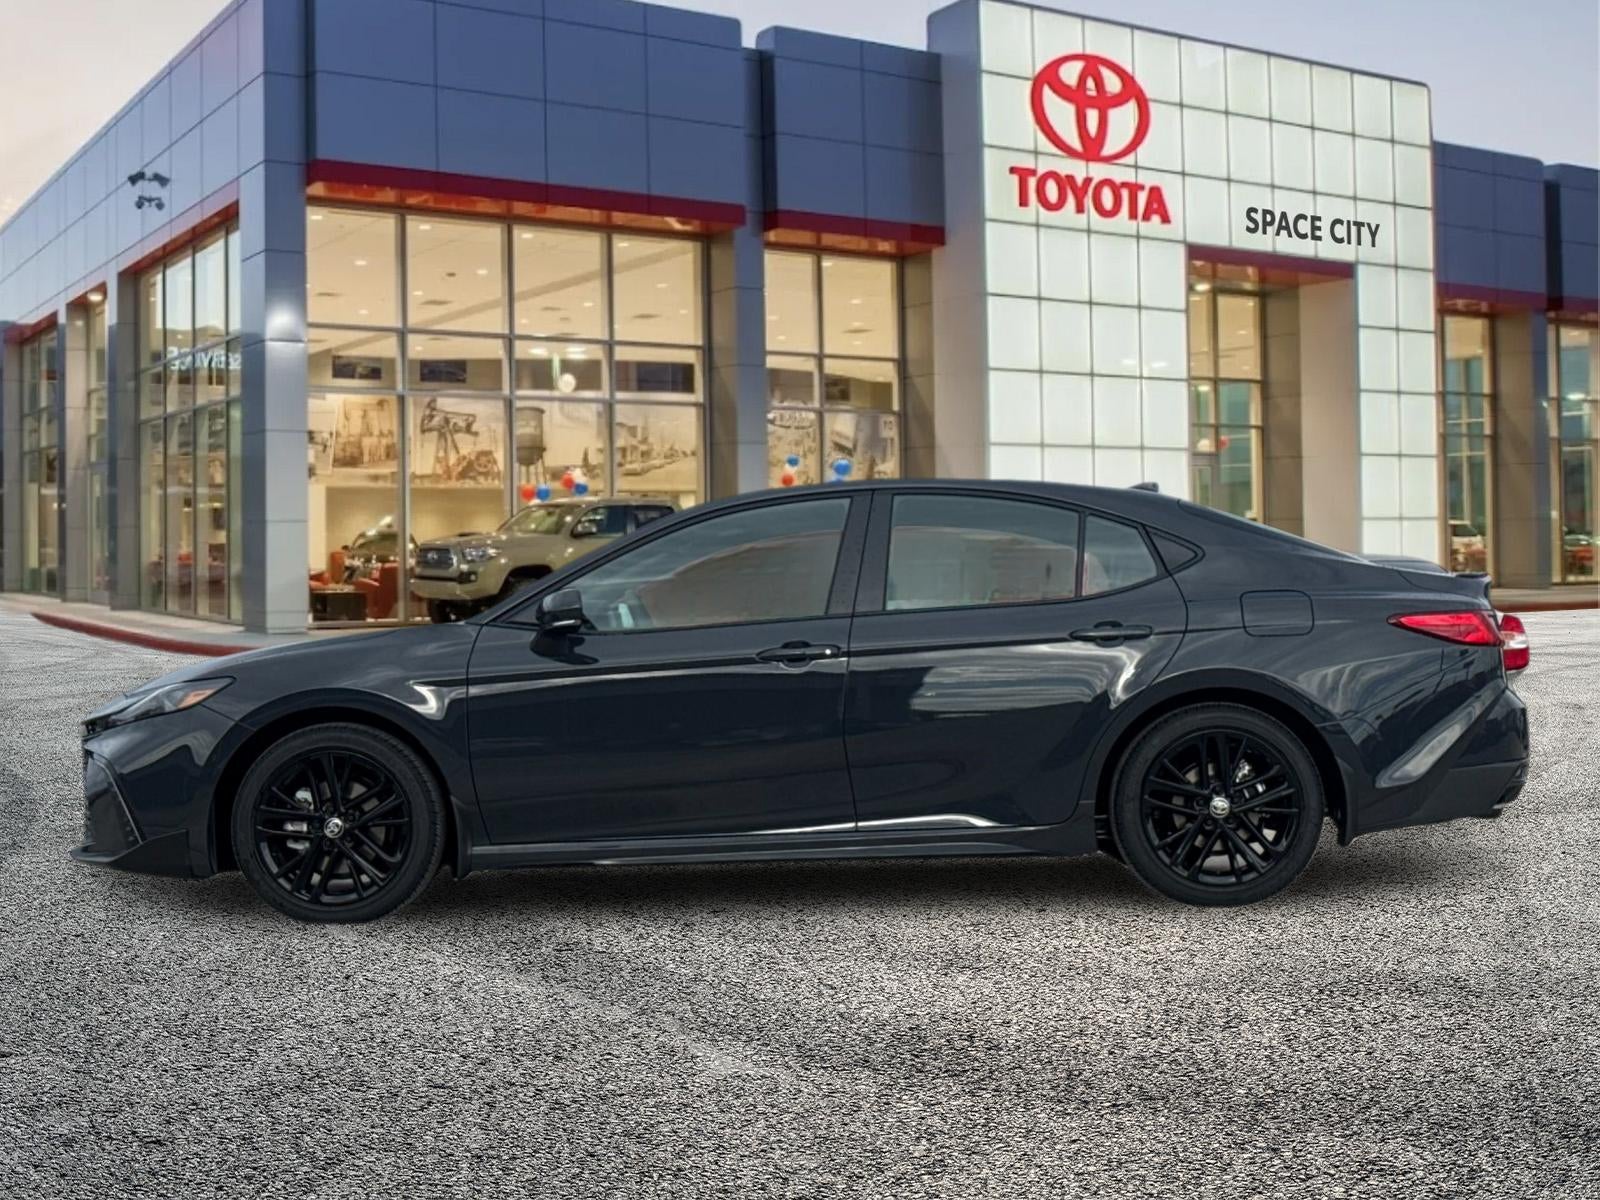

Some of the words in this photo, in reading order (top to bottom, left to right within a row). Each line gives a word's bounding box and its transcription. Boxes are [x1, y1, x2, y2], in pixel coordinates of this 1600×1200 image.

[1009, 166, 1171, 225] TOYOTA
[1245, 206, 1323, 242] SPACE
[1329, 218, 1381, 248] CITY
